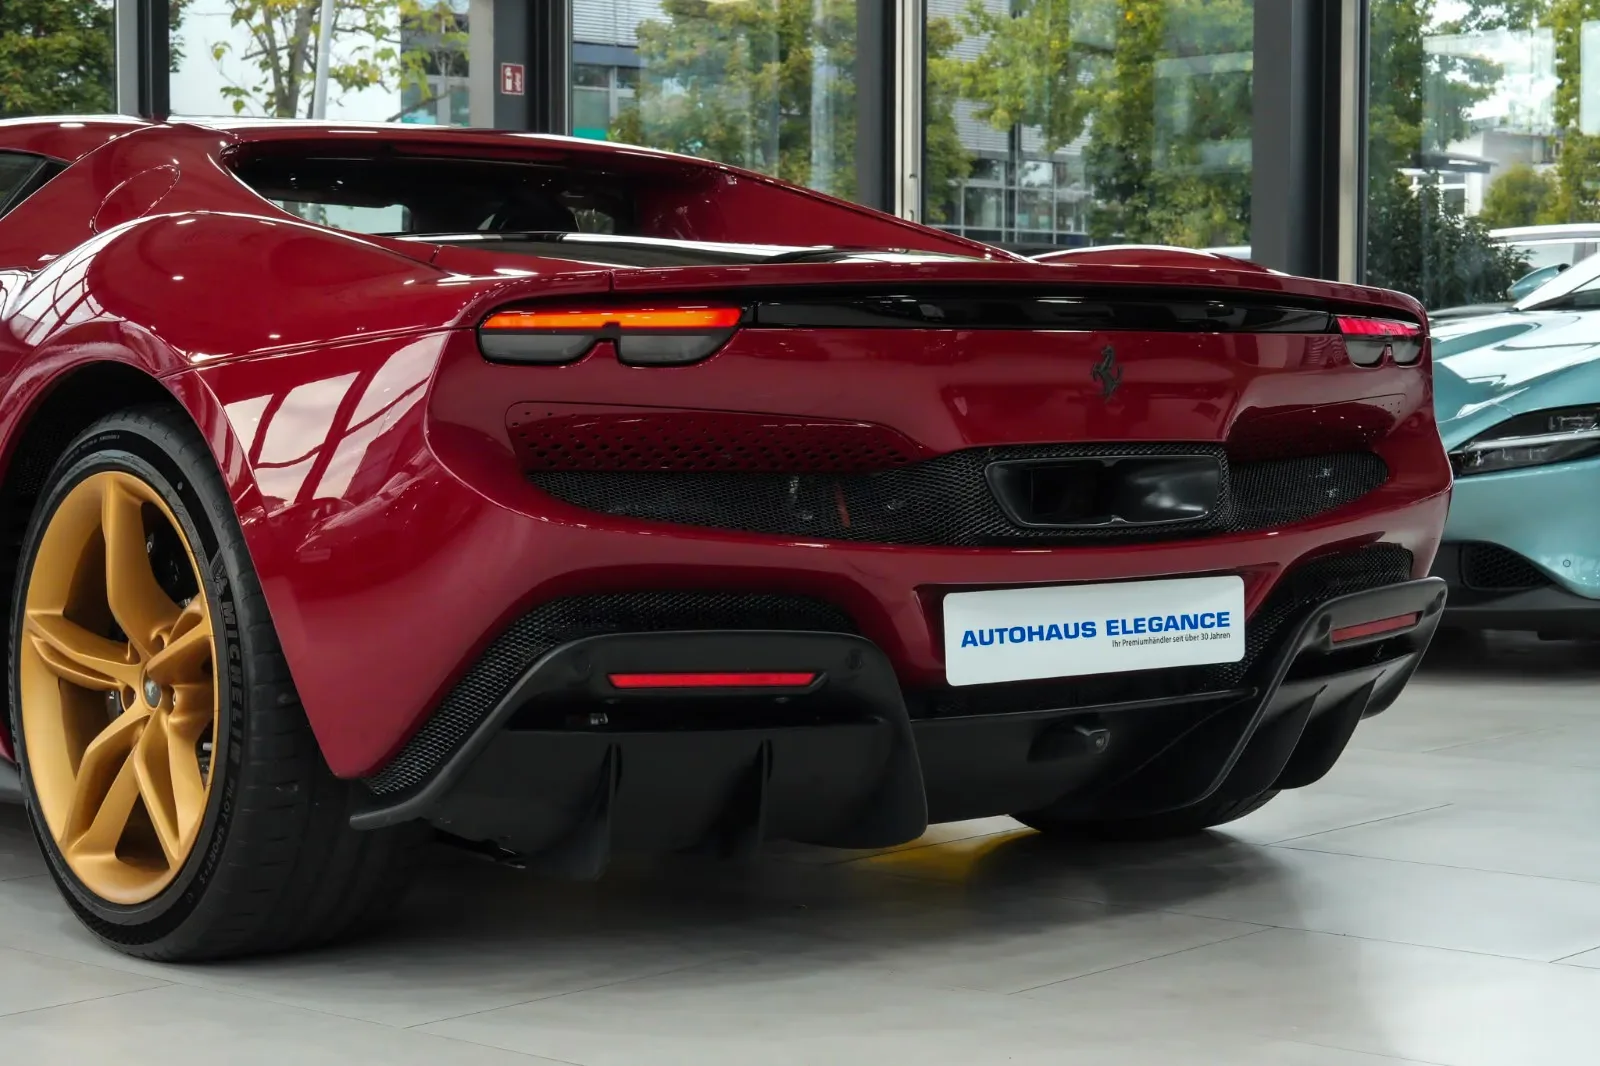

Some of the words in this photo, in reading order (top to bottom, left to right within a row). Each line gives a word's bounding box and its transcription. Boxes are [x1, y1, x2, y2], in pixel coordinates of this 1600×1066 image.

[961, 621, 1097, 648] AUTOHAUS
[1106, 611, 1230, 636] ELEGANCE
[1112, 639, 1121, 647] Ihr
[1122, 636, 1171, 646] Premiumhändler
[1185, 633, 1199, 641] über
[1200, 632, 1209, 640] 30
[1210, 632, 1231, 640] Jahren
[221, 600, 244, 765] MICHELIN
